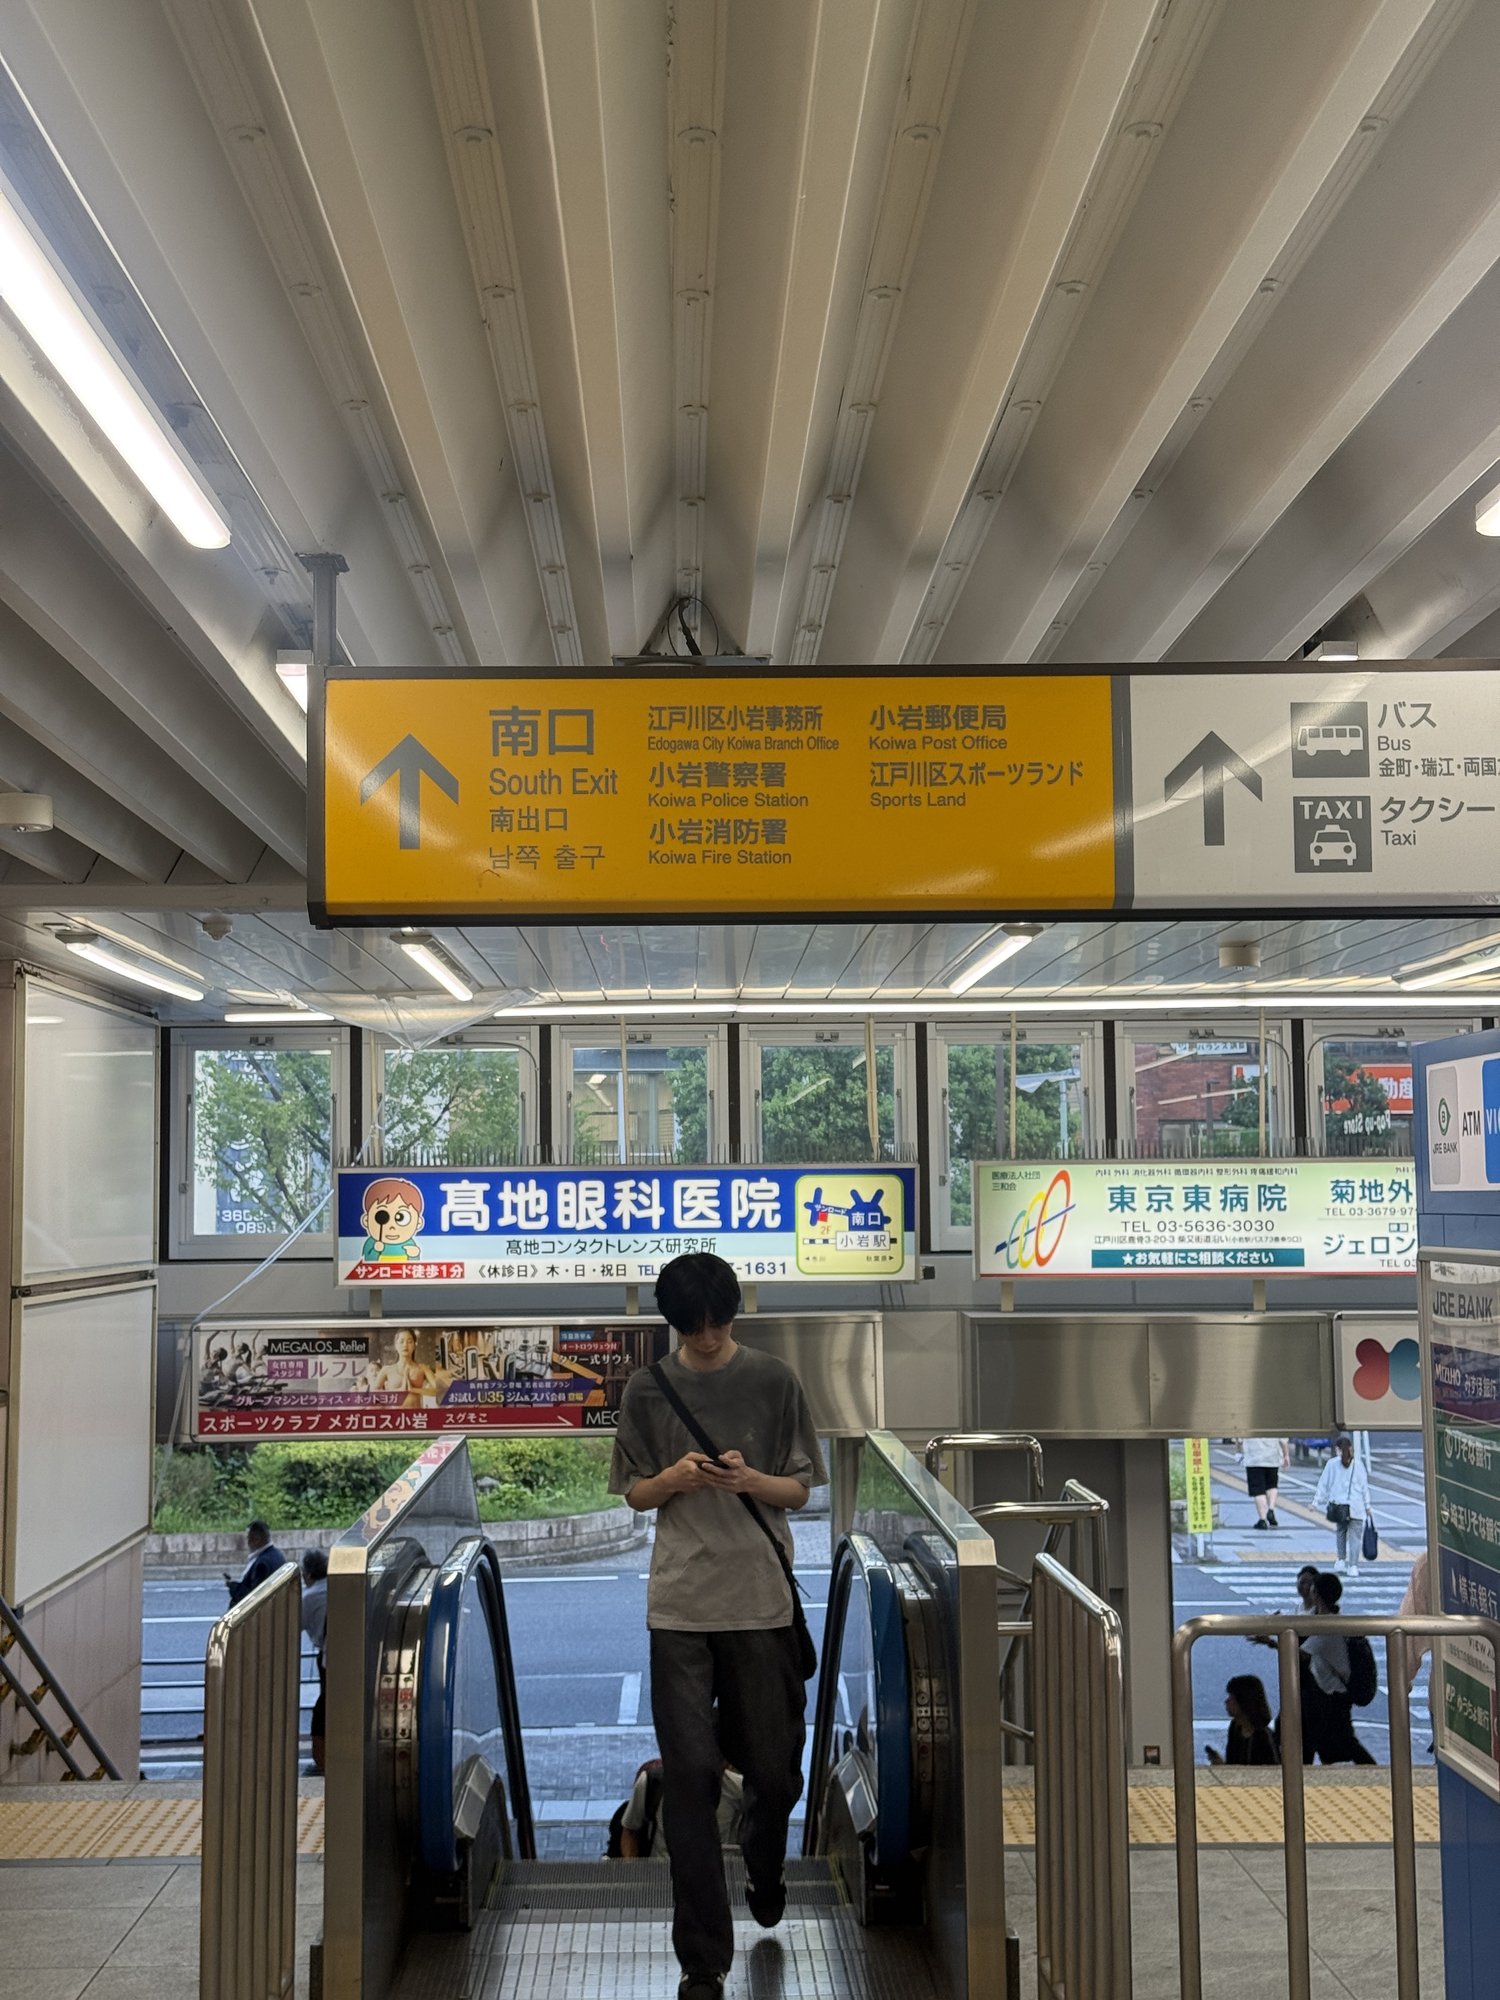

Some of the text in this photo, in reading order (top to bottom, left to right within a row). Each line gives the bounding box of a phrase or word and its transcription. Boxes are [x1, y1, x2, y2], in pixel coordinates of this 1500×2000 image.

[648, 705, 823, 731] 江戸川区小岩事務所
[869, 704, 1007, 731] 小岩郵便局
[1377, 701, 1437, 729] バス
[489, 705, 594, 757] 南口
[648, 736, 839, 753] Edogawa City Koiwa Branch Office
[869, 735, 1008, 750] Koiwa Post Office
[1377, 735, 1411, 751] Bus
[649, 761, 787, 788] 小岩警察署
[869, 761, 1084, 787] 江戸川区スポーツランド
[1378, 757, 1500, 778] 金町・瑞江・両国
[489, 768, 618, 795] South Exit
[648, 792, 809, 807] Koiwa Police Station
[870, 793, 966, 810] Sports Land
[489, 805, 568, 832] 南出口
[1299, 800, 1364, 820] TAXI
[1380, 796, 1496, 825] タクシー
[649, 818, 787, 845] 小岩消防署
[1380, 830, 1417, 846] Taxi
[489, 844, 606, 870] 남쪽 출구
[648, 850, 792, 864] Koiwa Fire Station
[1462, 1110, 1481, 1136] ATM
[1433, 1142, 1458, 1154] JRE BANK
[991, 1171, 1041, 1180] 医療法人社団
[991, 1182, 1017, 1191] 三和会
[1330, 1179, 1413, 1203] 菊地外
[1108, 1184, 1288, 1213] 東京東病院
[815, 1204, 847, 1215] サンロード
[851, 1212, 881, 1226] 南口
[1325, 1207, 1418, 1216] TEL 03-3679-97
[820, 1226, 831, 1235] 2F
[1121, 1220, 1275, 1233] TEL 03-5636-3030
[840, 1235, 887, 1248] 小岩駅
[1324, 1234, 1416, 1255] ジェロン
[355, 1264, 464, 1279] サンロード徒歩1分
[1380, 1259, 1400, 1267] TEL
[1433, 1291, 1493, 1323] JRE BANK
[272, 1361, 304, 1369] 女性専用
[560, 1353, 632, 1365] タワー式サウナ
[272, 1369, 303, 1378] スタジオ
[311, 1360, 366, 1378] ルフレ
[1436, 1363, 1461, 1387] MIZUHO
[1464, 1373, 1497, 1401] みずほ銀行
[203, 1411, 428, 1432] スポーツクラブ メガロス小岩
[445, 1412, 488, 1424] スグそこ
[1459, 1573, 1498, 1620] 横浜銀行
[1457, 1694, 1489, 1731] ゆうちょ銀行
